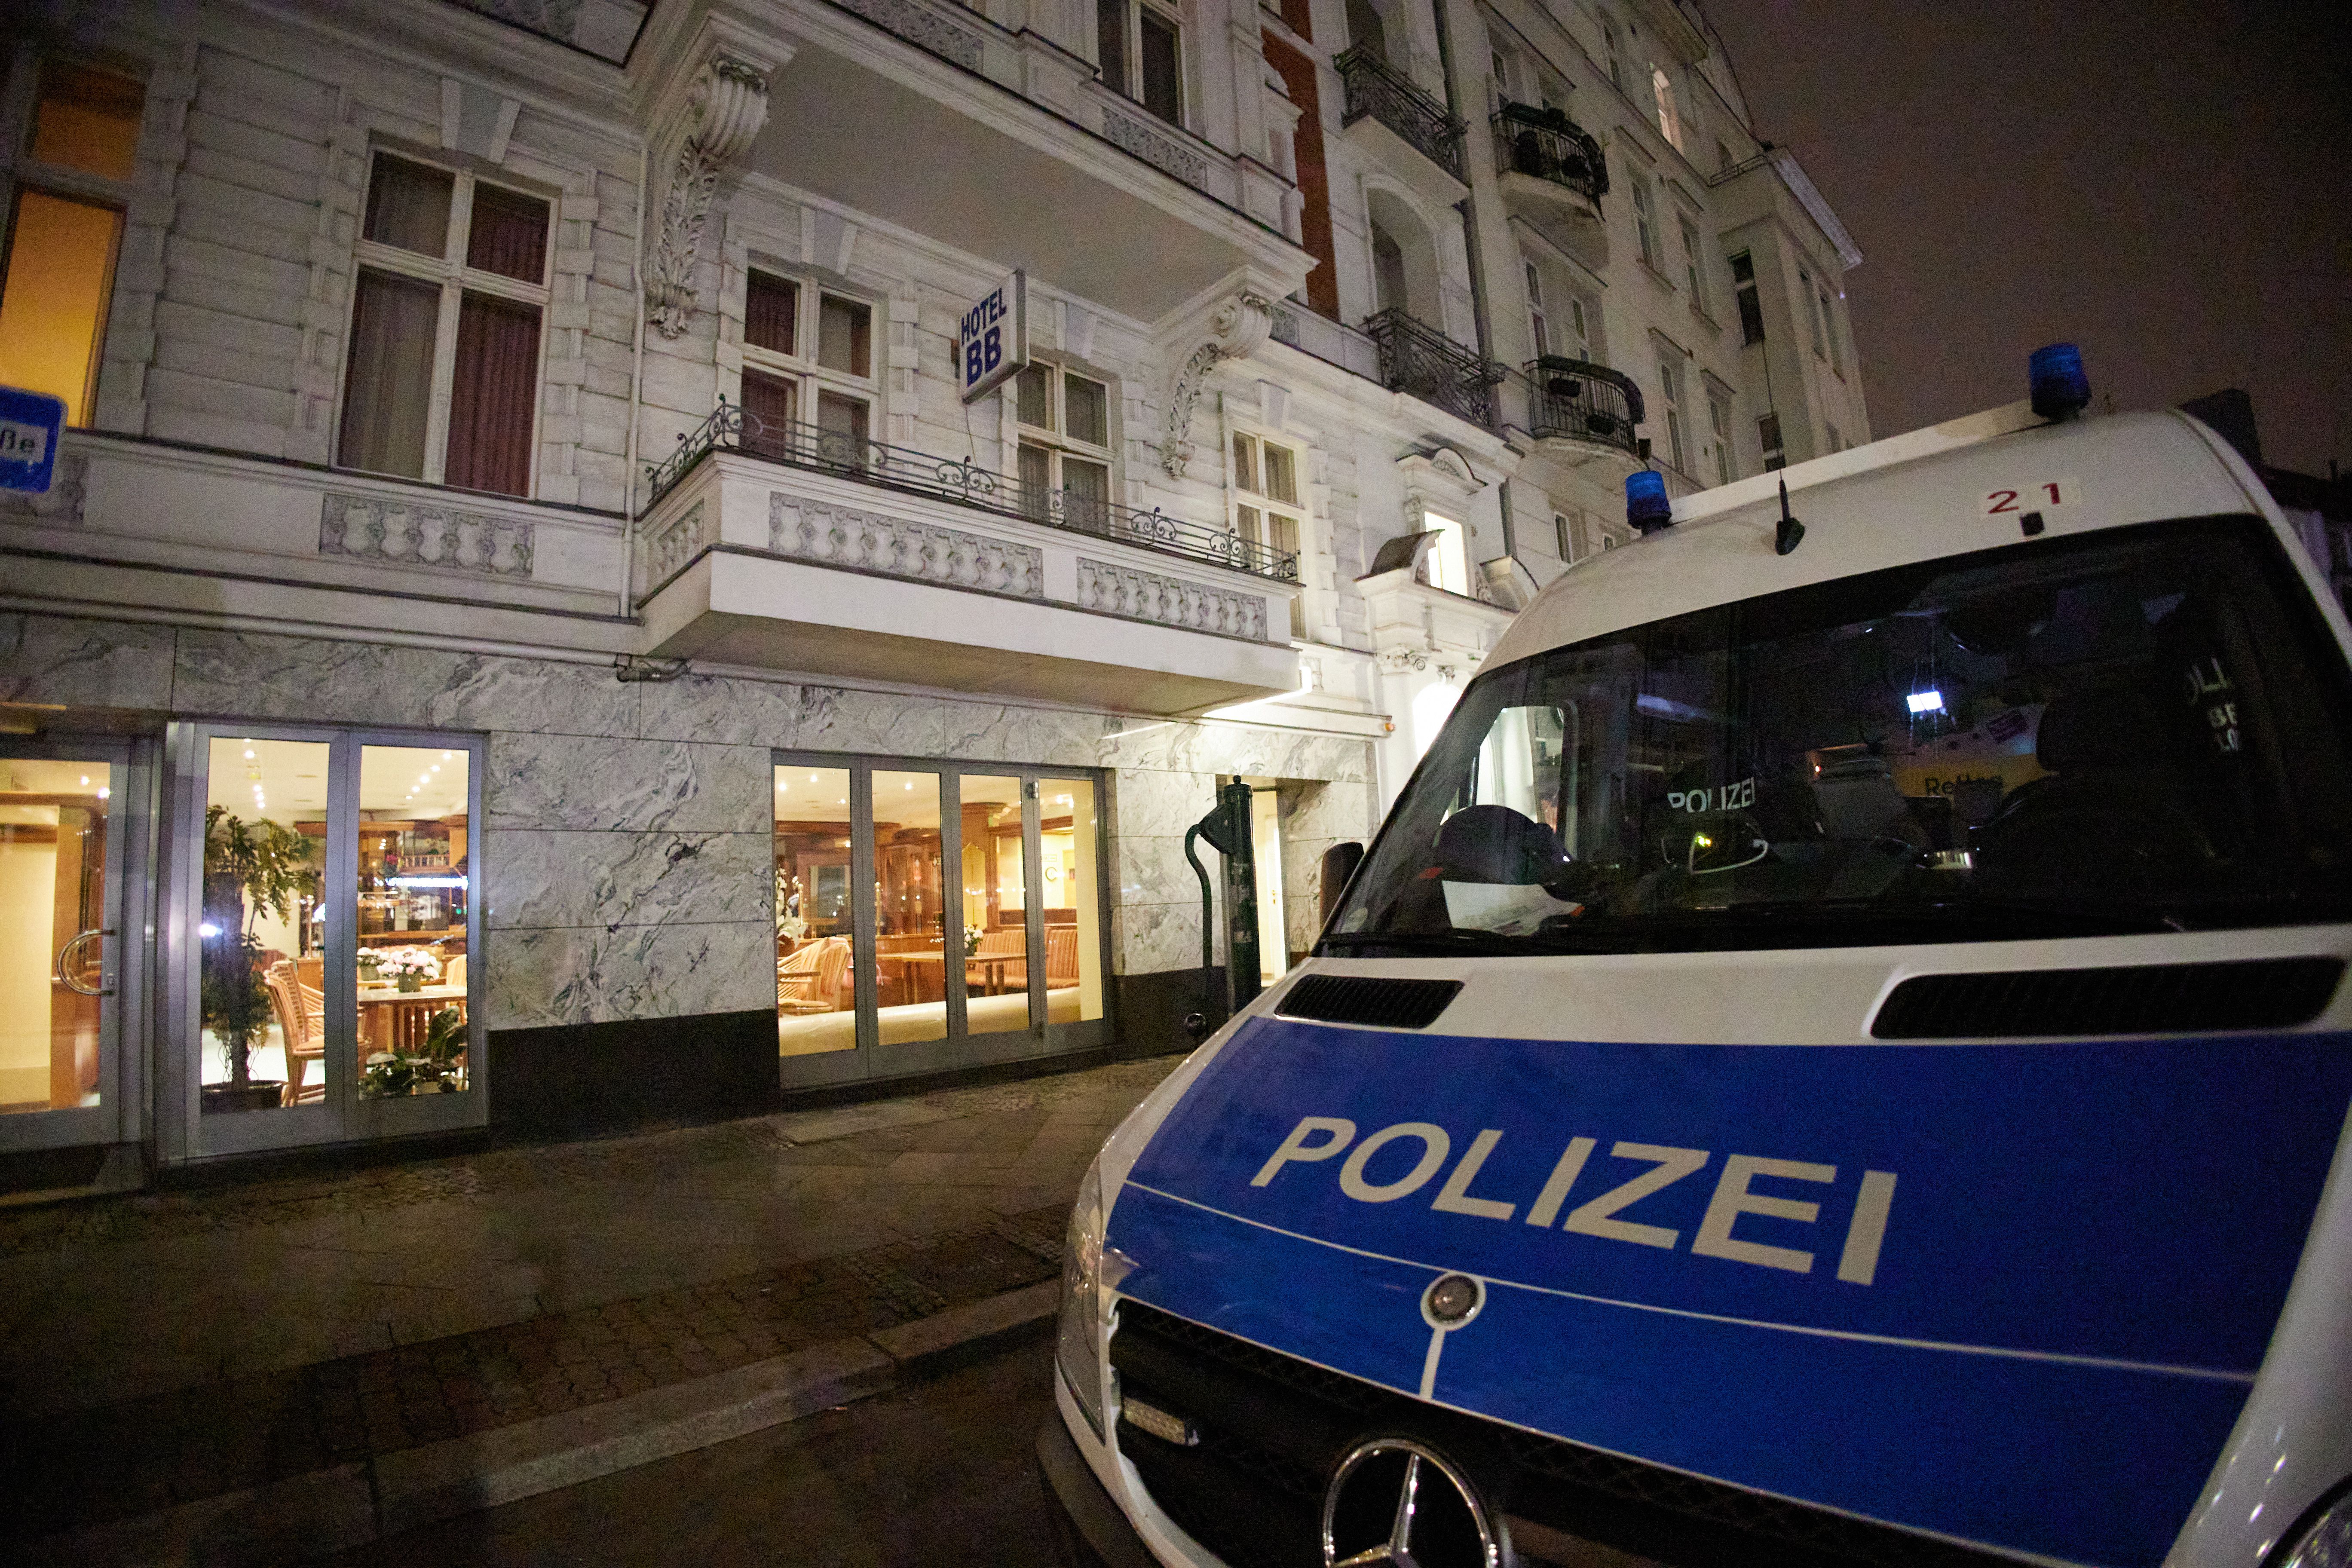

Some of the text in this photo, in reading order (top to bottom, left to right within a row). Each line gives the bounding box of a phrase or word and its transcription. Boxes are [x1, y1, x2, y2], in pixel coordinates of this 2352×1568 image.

[961, 288, 1007, 346] HOTEL
[966, 325, 1002, 387] BB
[1667, 776, 1756, 814] POLIZEI
[1250, 1116, 1898, 1285] POLIZEI
